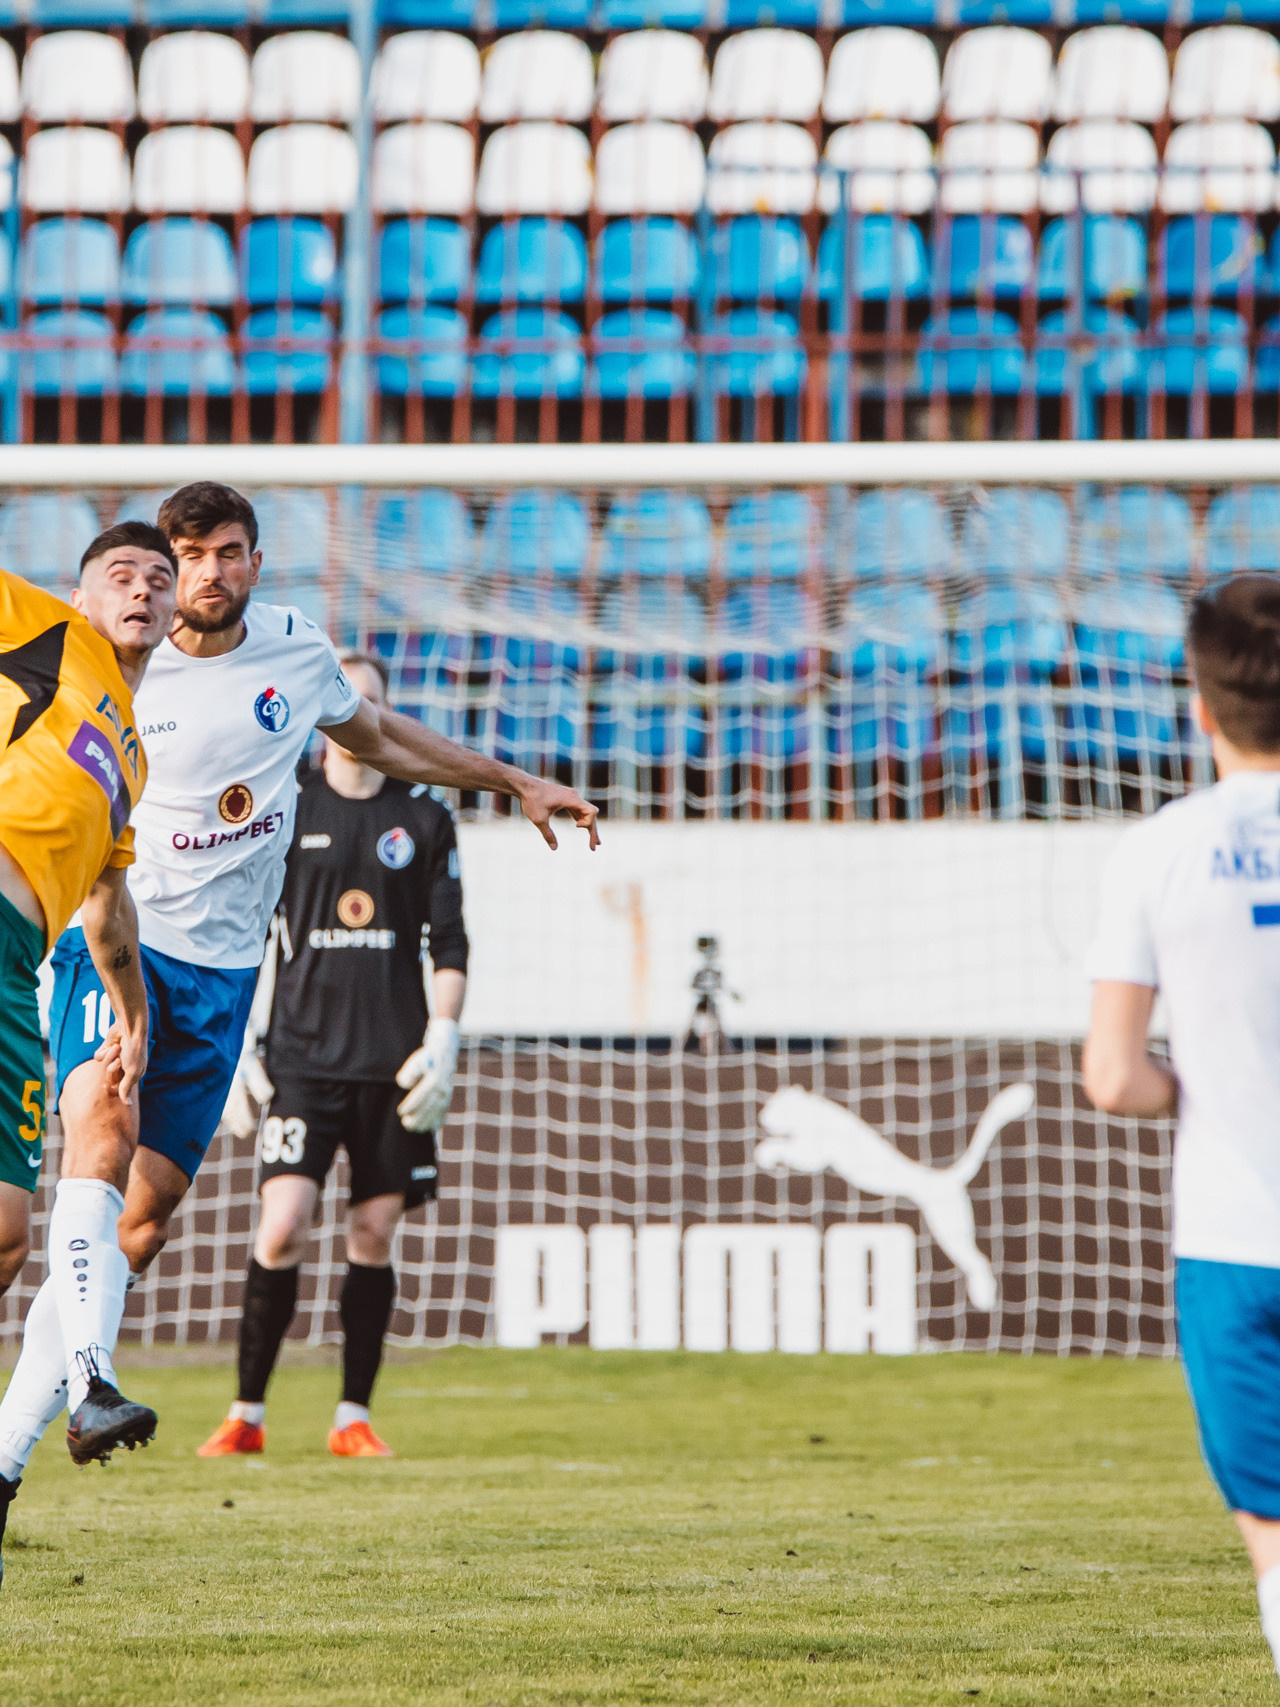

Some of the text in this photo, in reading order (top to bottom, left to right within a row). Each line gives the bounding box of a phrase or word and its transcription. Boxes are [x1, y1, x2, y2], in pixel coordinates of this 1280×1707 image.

[141, 721, 177, 737] JAKO
[172, 811, 284, 850] OLIMPBET
[262, 1115, 307, 1165] 93
[495, 1223, 917, 1354] PUMA
